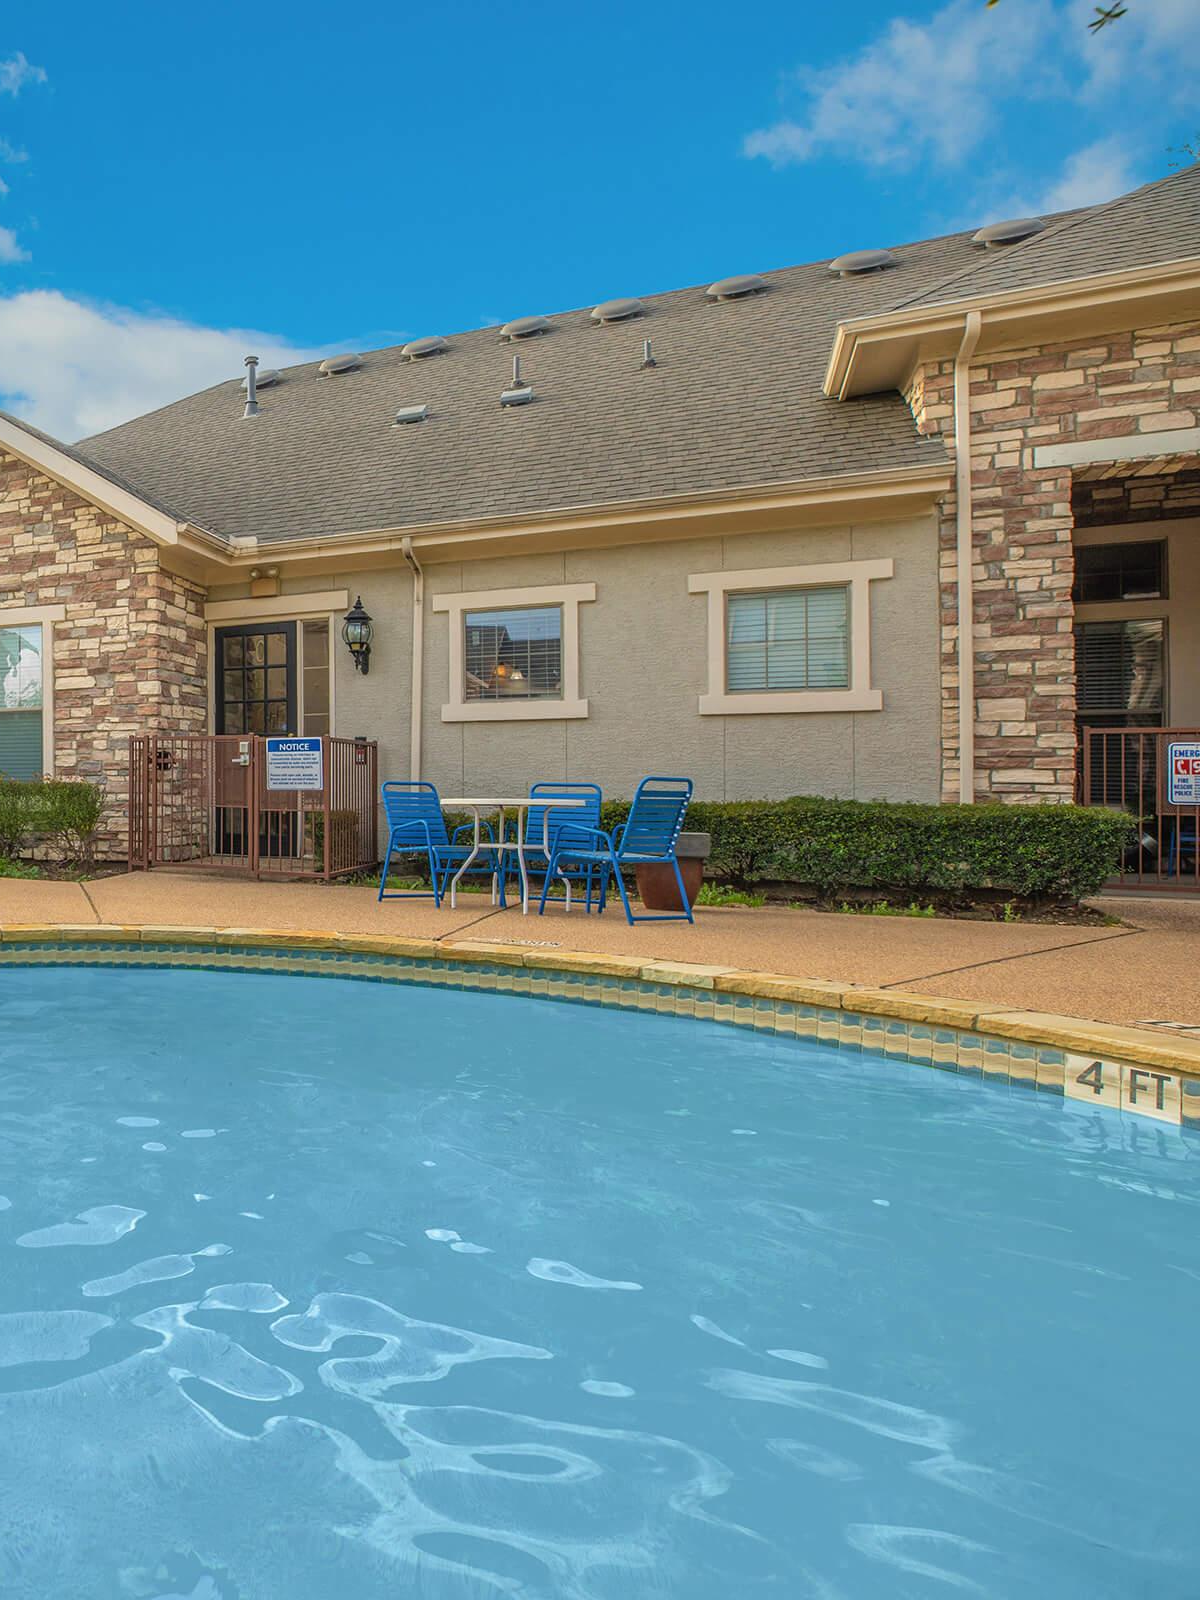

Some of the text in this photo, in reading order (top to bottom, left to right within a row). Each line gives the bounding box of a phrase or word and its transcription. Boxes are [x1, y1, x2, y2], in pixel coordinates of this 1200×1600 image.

[279, 743, 310, 751] NOTICE
[1076, 1061, 1171, 1110] 4 FT
